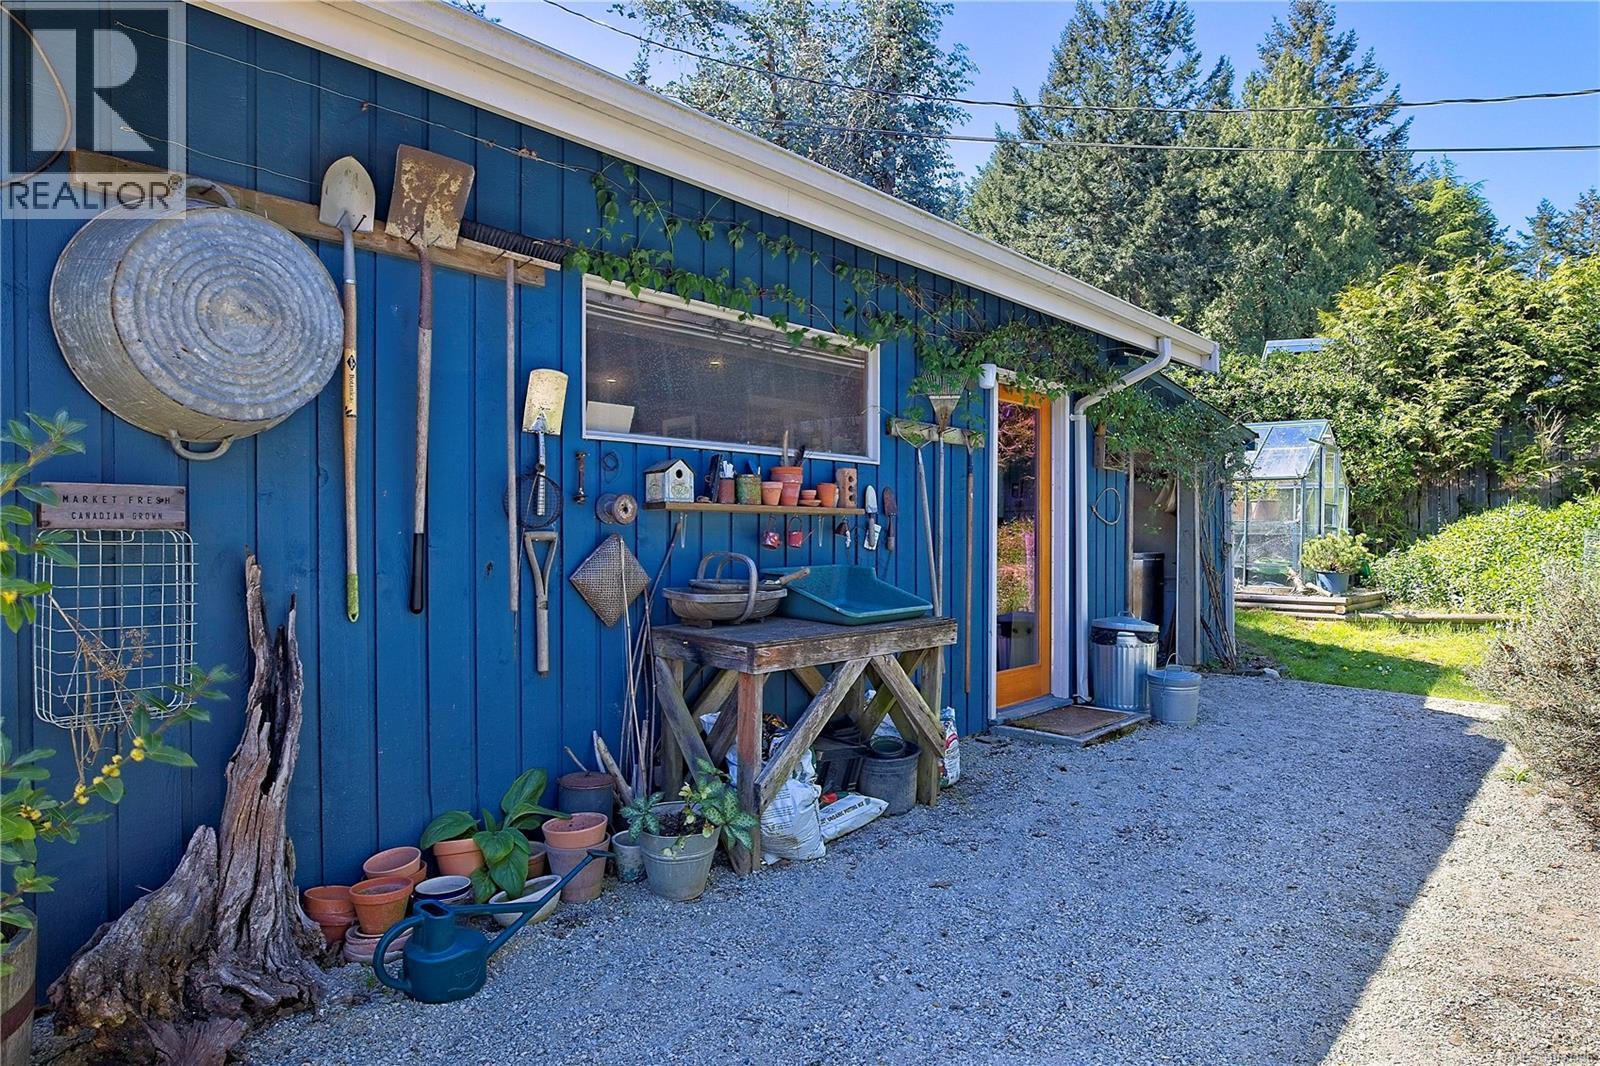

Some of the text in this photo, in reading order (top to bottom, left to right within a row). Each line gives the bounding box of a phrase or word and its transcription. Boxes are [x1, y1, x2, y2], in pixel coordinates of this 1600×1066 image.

[62, 495, 170, 505] MARKET FRESH
[71, 511, 163, 521] CANADIAN GROWN
